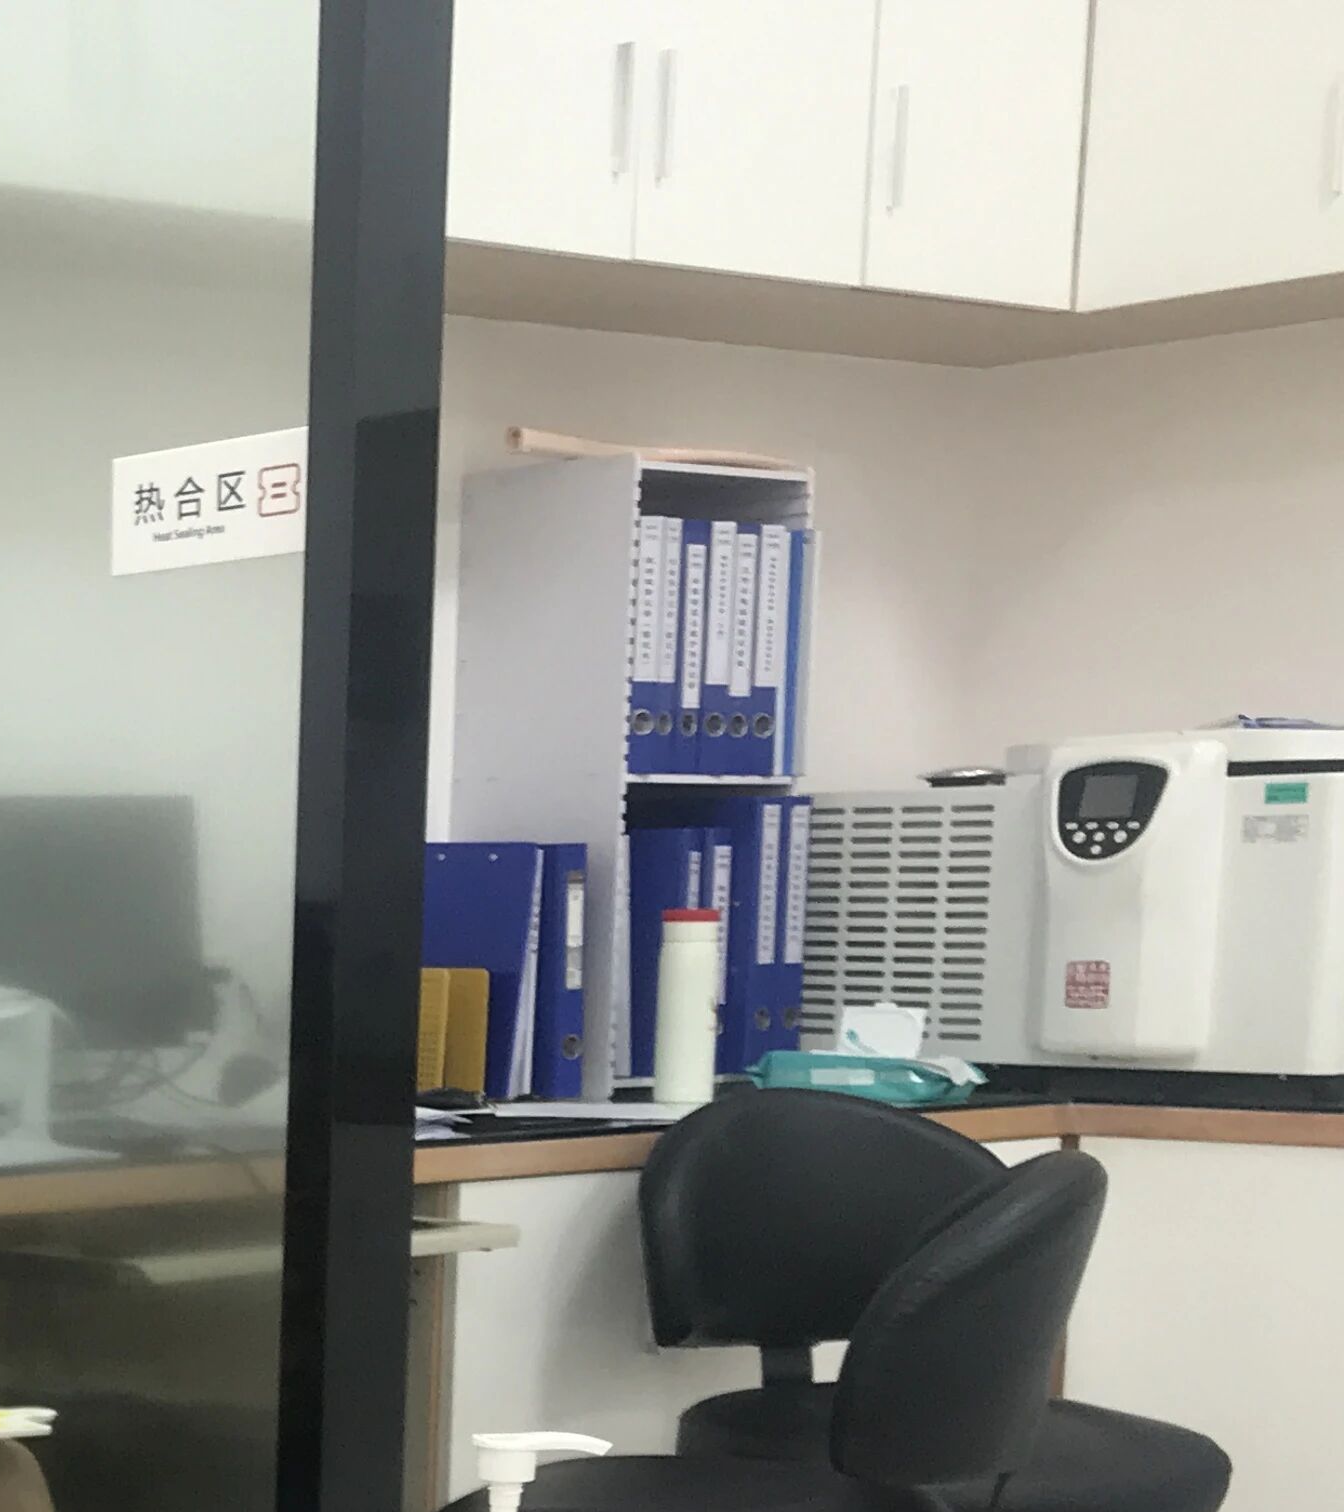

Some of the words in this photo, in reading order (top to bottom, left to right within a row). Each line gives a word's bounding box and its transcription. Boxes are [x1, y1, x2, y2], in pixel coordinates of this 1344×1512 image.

[134, 470, 247, 526] 热合区
[152, 530, 173, 542] Heat
[174, 526, 204, 540] Sealing
[206, 524, 226, 535] Area
